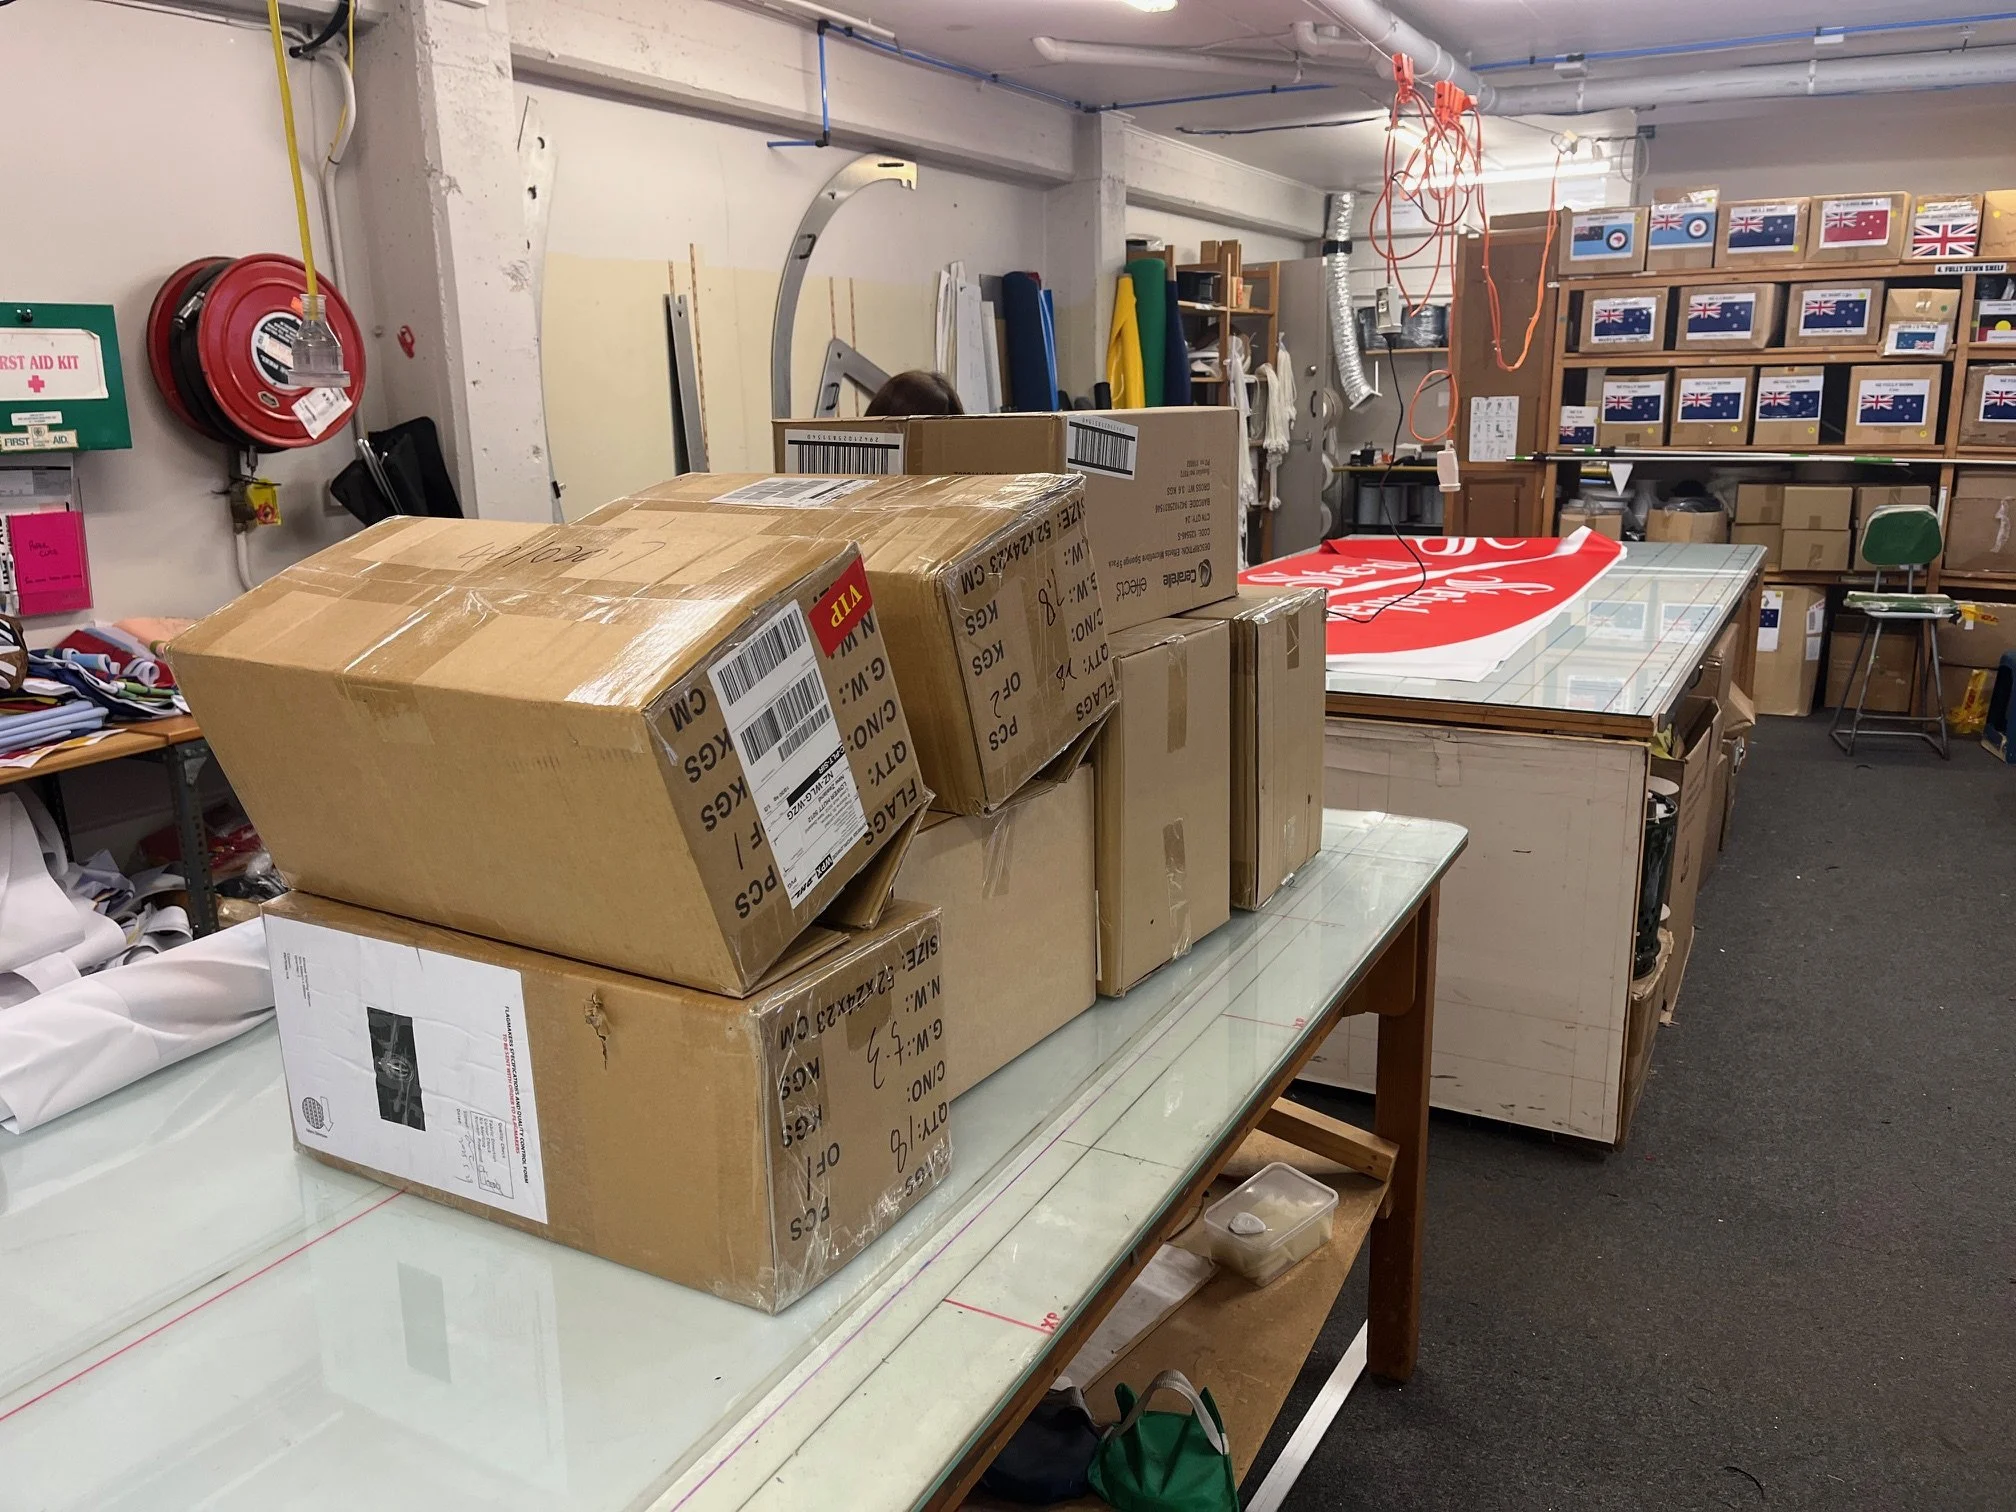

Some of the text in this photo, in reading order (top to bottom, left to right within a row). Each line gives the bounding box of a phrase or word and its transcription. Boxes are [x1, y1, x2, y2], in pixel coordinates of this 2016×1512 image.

[1945, 264, 1962, 273] FULLY
[1964, 263, 1984, 272] SEWN
[1985, 262, 2006, 271] SHELF
[30, 355, 53, 369] AID
[57, 355, 79, 369] KIT
[4, 435, 69, 447] FIRST AID
[961, 565, 985, 594] CM
[965, 536, 1089, 635] .W.: KGS
[831, 585, 862, 626] VIP
[1071, 608, 1103, 641] C/NO:
[972, 640, 1004, 676] KGS
[1083, 643, 1108, 674] QTY:
[1003, 672, 1021, 700] OF
[1076, 679, 1114, 721] FLAGS
[669, 688, 706, 730] CM
[847, 700, 896, 750] C/NO:
[701, 657, 885, 831] G.W.: KGS
[989, 716, 1017, 751] PCS
[685, 728, 732, 782] KGS
[787, 771, 833, 819] NZ-WLG-WZG
[818, 797, 830, 812] HUTT
[830, 781, 847, 800] LOWER
[735, 741, 906, 918] QTY: PCS
[864, 779, 916, 844] FLAGS
[750, 821, 765, 849] F
[787, 877, 797, 888] PVG
[815, 854, 832, 877] WPX
[794, 877, 813, 898] DHL
[902, 935, 937, 971] SIZE:
[780, 1015, 808, 1049] CM
[780, 976, 940, 1099] N.W.: KGS
[907, 1019, 942, 1055] G.W.:
[505, 1006, 514, 1047] FLAGMAKERS
[510, 1048, 520, 1095] SPECIFICATIONS
[907, 1061, 945, 1102] C/NO:
[512, 1115, 520, 1154] FLAGMAKERS
[781, 1104, 822, 1148] KGS
[918, 1102, 947, 1140] QTY:
[816, 1142, 840, 1177] OF
[790, 1197, 829, 1241] PCS
